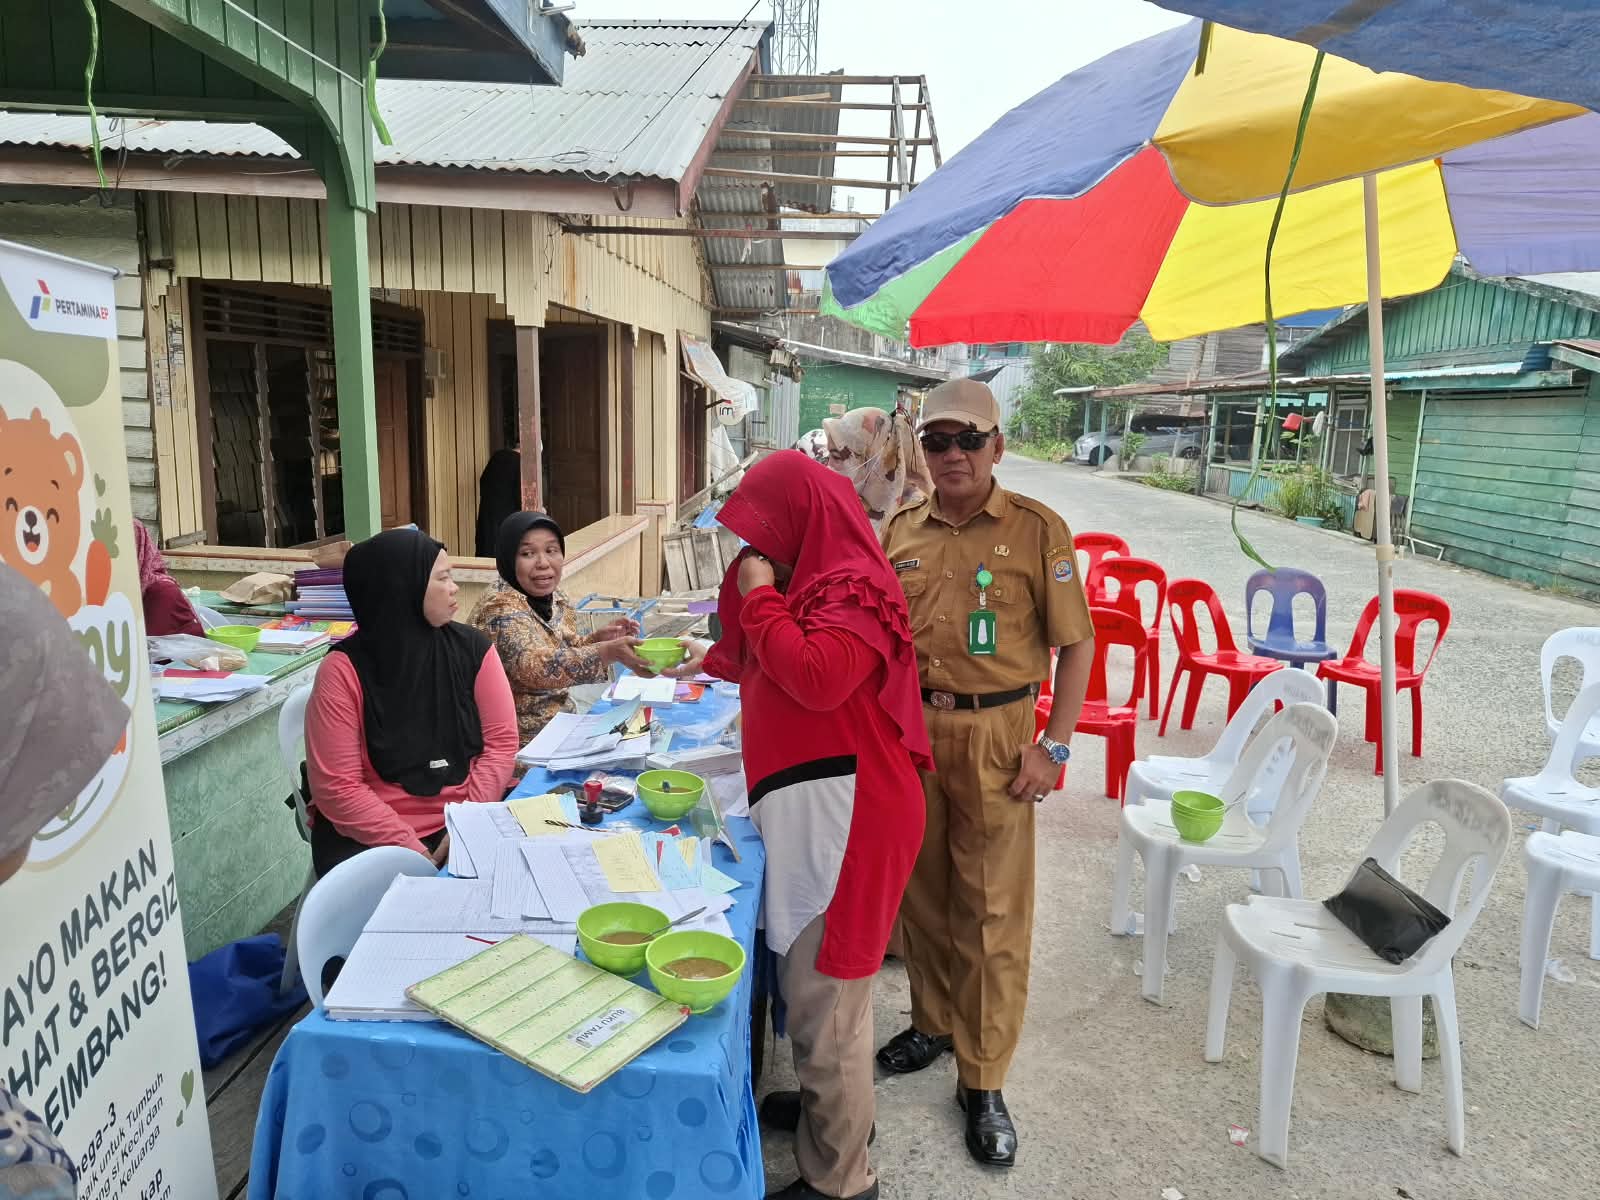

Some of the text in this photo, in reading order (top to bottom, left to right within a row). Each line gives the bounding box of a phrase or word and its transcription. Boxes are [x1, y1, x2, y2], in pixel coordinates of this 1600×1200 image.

[3, 838, 157, 1047] AYO MAKAN
[69, 979, 88, 1028] &
[92, 872, 178, 998] BERGIZ
[576, 1009, 625, 1043] BUKU TAMU
[100, 1127, 125, 1174] untuk
[126, 1072, 163, 1128] Tumbuh
[111, 1158, 120, 1180] si
[121, 1119, 144, 1164] Kecil
[146, 1096, 163, 1126] dan
[119, 1125, 160, 1193] Keluarga
